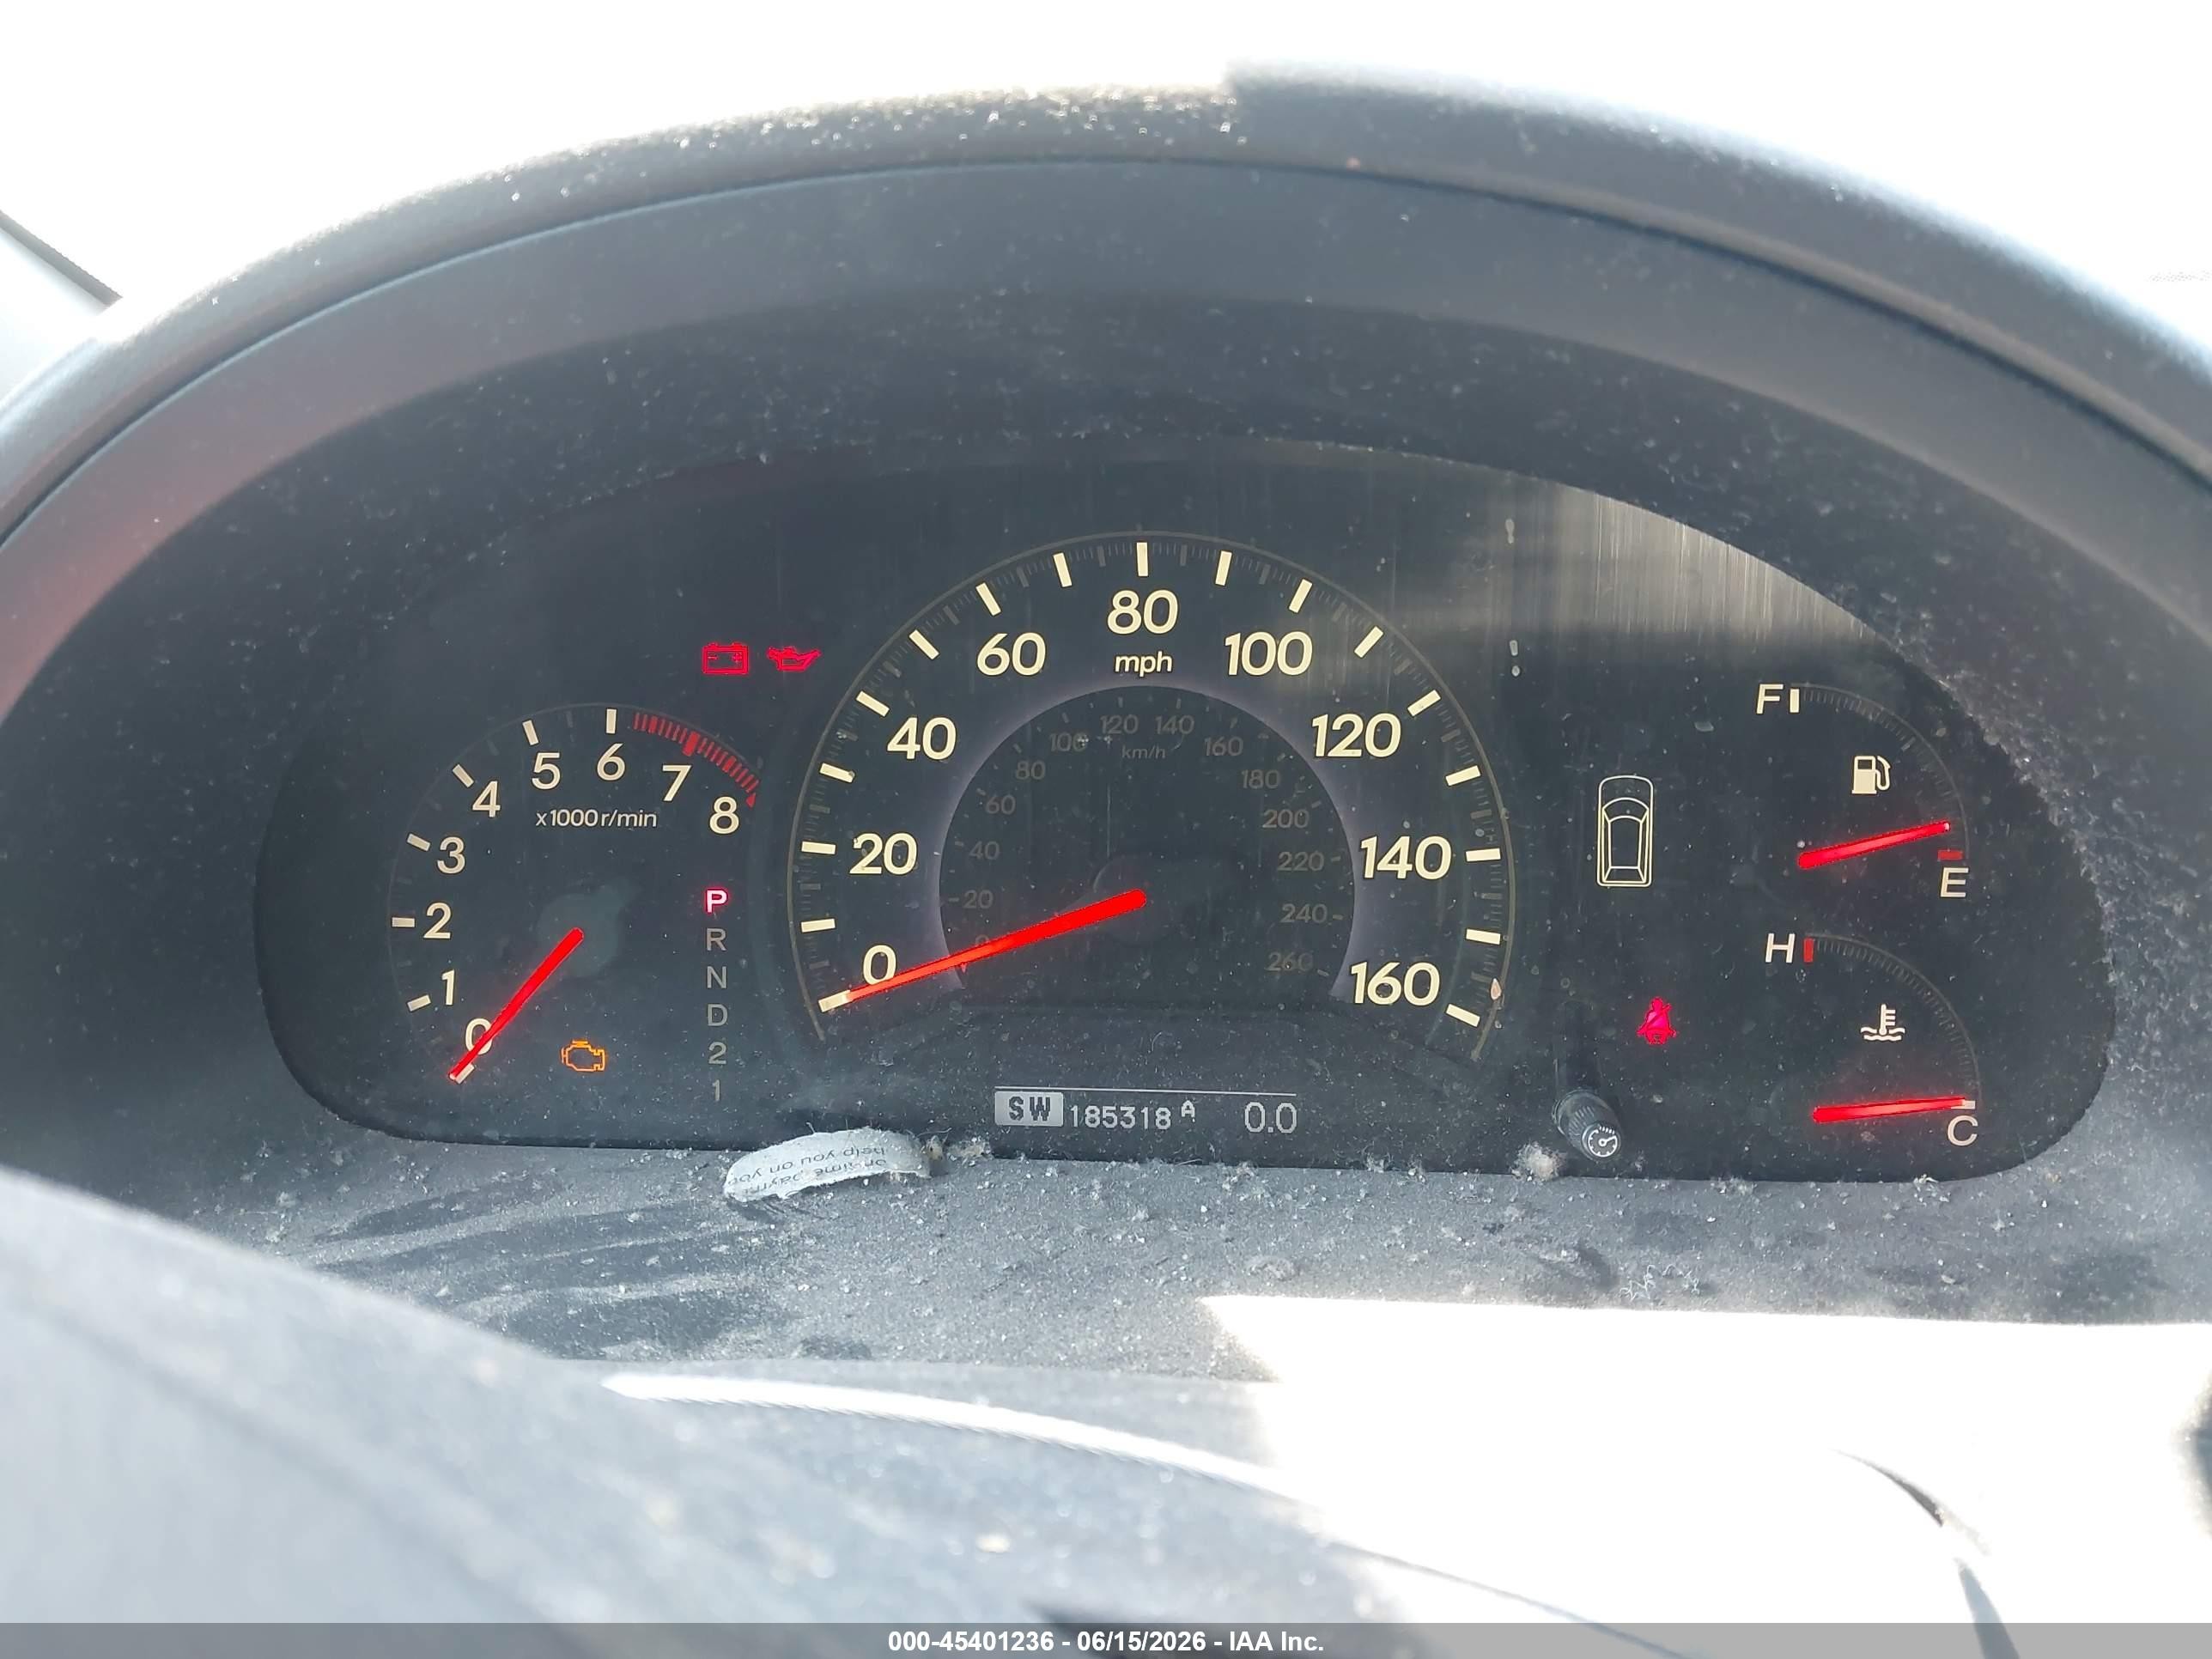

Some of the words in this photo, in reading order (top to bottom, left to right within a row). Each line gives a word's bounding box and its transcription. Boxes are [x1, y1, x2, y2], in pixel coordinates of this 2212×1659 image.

[1107, 589, 1178, 635] 80
[976, 632, 1047, 676] 60
[1115, 650, 1173, 677] mph
[1224, 631, 1313, 676] 100
[1756, 684, 1784, 714] F
[1100, 714, 1139, 734] 120
[1155, 714, 1195, 735] 140
[1311, 713, 1401, 757] 120
[887, 717, 957, 760] 40
[1121, 744, 1166, 759] km/h
[1204, 736, 1243, 757] 160
[531, 751, 561, 789] 5
[596, 743, 626, 781] 6
[1016, 761, 1046, 780] 80
[661, 764, 691, 802] 7
[1241, 769, 1281, 789] 180
[471, 781, 501, 817] 4
[985, 794, 1016, 815] 60
[708, 796, 740, 835] 8
[1262, 810, 1310, 829] 200
[436, 836, 466, 874] 3
[849, 832, 917, 875] 20
[969, 841, 1000, 860] 40
[1277, 852, 1324, 872] 220
[1359, 835, 1452, 880] 140
[1941, 868, 1968, 897] E
[706, 889, 727, 913] P
[963, 890, 994, 908] 20
[423, 902, 452, 939] 2
[1280, 904, 1328, 924] 240
[706, 927, 726, 951] R
[1765, 933, 1796, 963] H
[862, 945, 897, 986] 0
[1267, 951, 1313, 972] 260
[441, 969, 455, 1006] 1
[706, 965, 726, 988] N
[1350, 961, 1440, 1006] 160
[707, 1004, 727, 1026] D
[465, 1018, 494, 1054] 0
[708, 1042, 726, 1065] 2
[712, 1079, 721, 1101] 1
[1008, 1097, 1051, 1121] SW
[1070, 1105, 1172, 1130] 185318
[1181, 1100, 1195, 1117] A
[1245, 1101, 1297, 1133] 0.0
[1947, 1115, 1978, 1146] C
[800, 1149, 835, 1165] you
[843, 1146, 884, 1157] help
[769, 1161, 793, 1174] on
